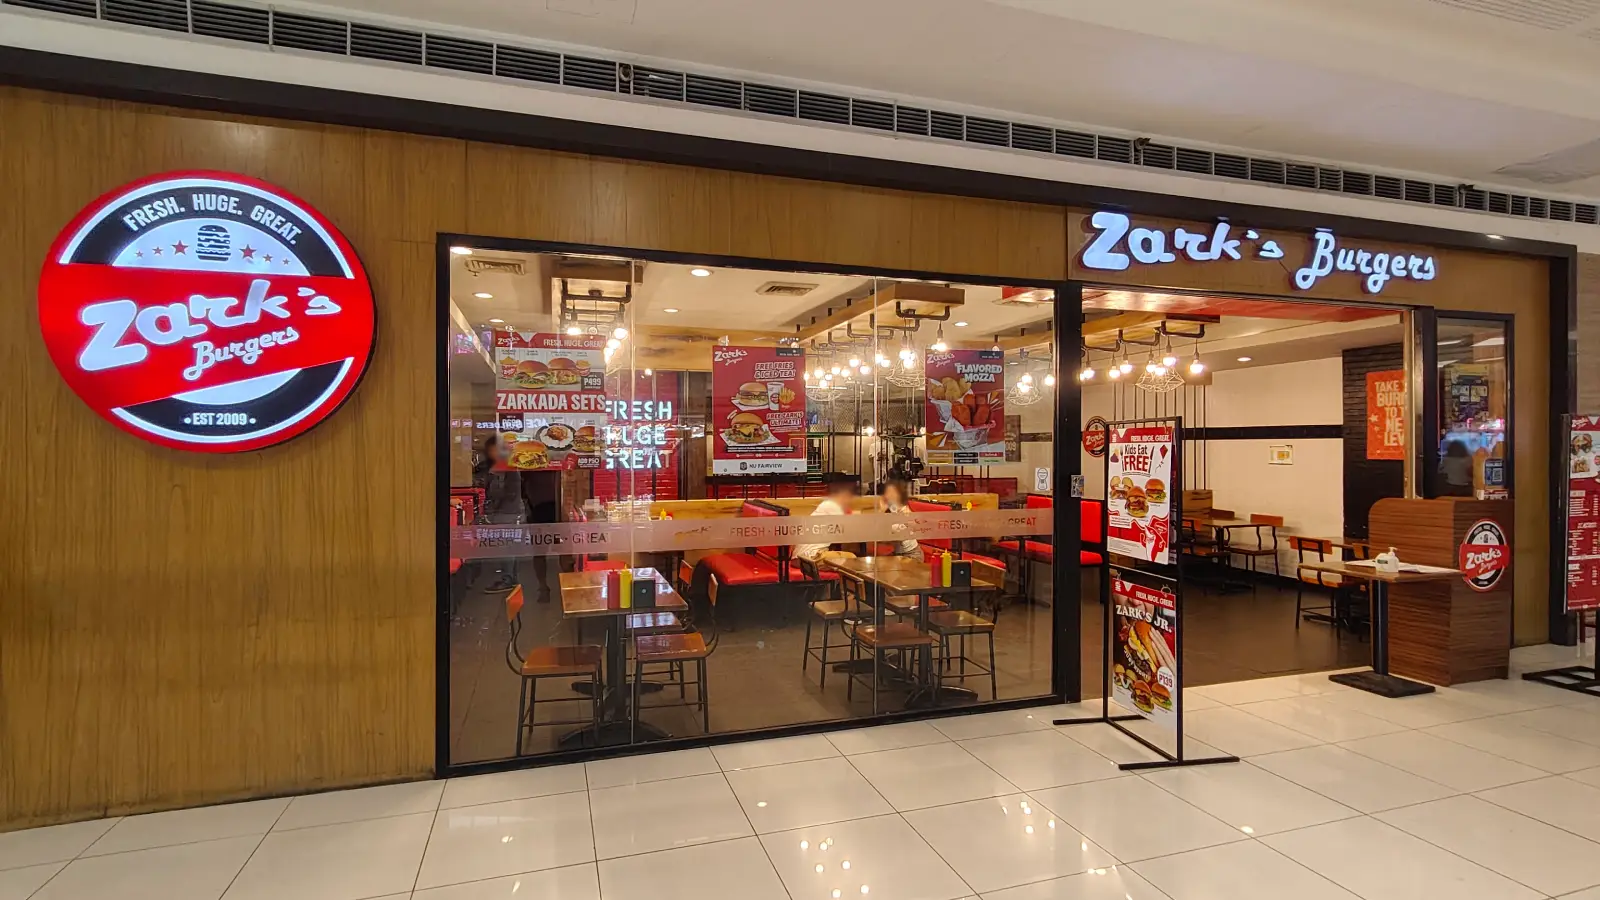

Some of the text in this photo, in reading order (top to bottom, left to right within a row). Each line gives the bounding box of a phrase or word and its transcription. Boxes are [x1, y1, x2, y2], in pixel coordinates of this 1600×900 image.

[123, 193, 302, 245] FRESH. HUGE. GREAT.
[1082, 211, 1284, 271] Zark's
[1295, 228, 1436, 294] Burgers
[79, 279, 342, 371] Zark's
[183, 327, 300, 381] Burgers
[955, 363, 1002, 374] FLAVORED
[964, 373, 995, 382] MOZZA
[1374, 380, 1399, 393] TAKE
[497, 393, 606, 411] ZARKADA SETS
[605, 400, 672, 420] FRESH
[192, 412, 247, 426] EST 2009
[1385, 407, 1398, 417] TO
[1124, 444, 1148, 455] Kids Eat
[774, 524, 803, 537] HUGE
[1116, 604, 1172, 633] ZARK'S JR.
